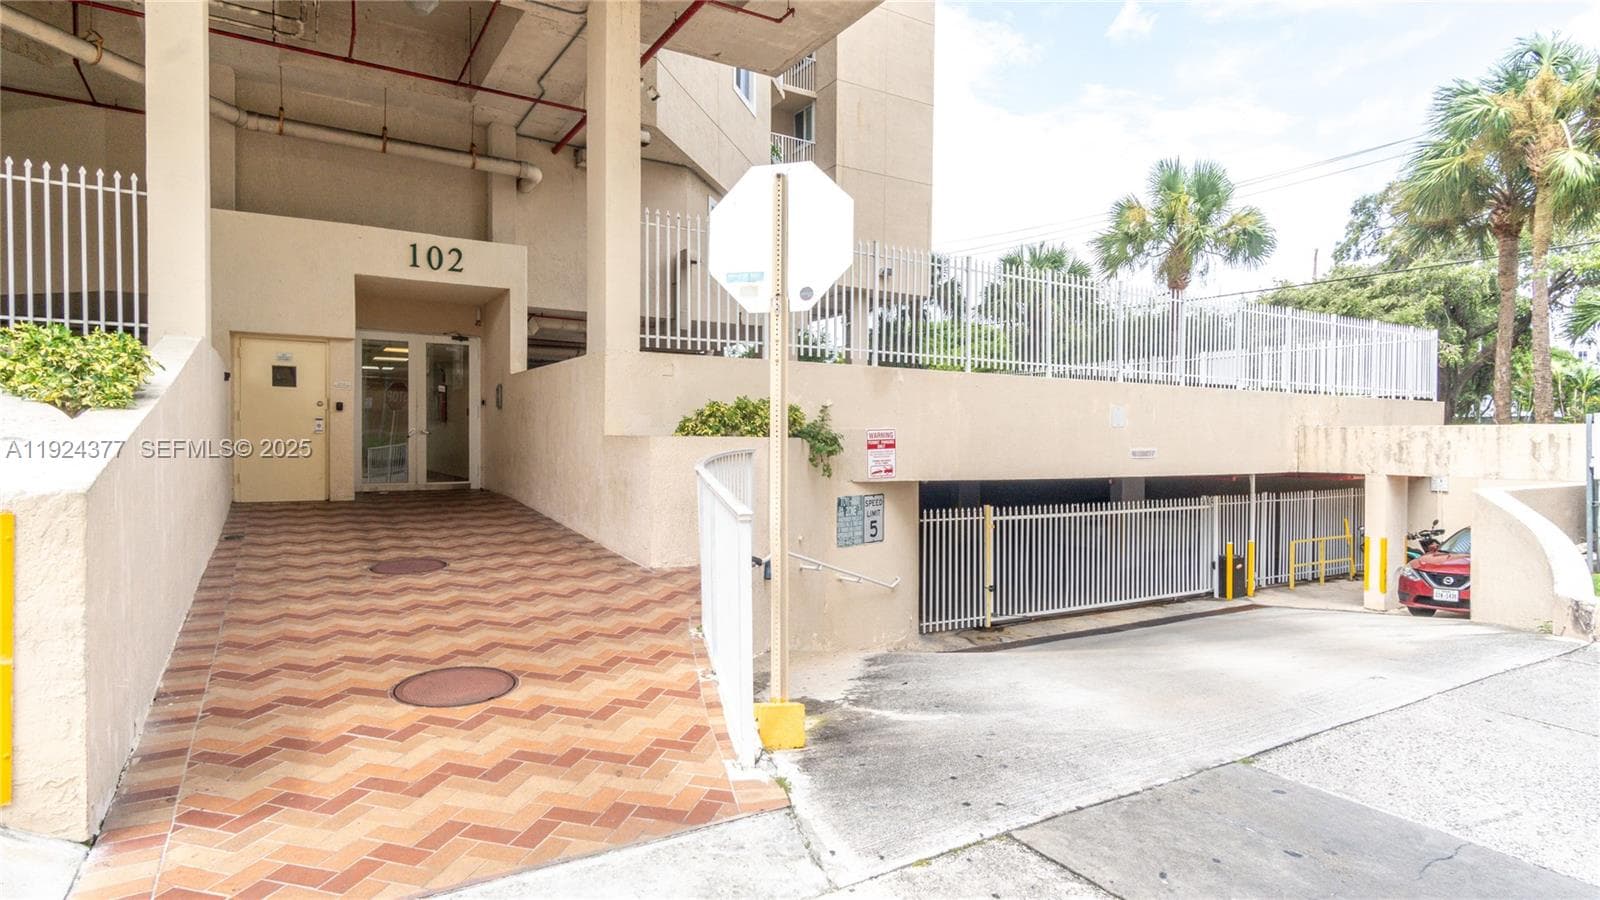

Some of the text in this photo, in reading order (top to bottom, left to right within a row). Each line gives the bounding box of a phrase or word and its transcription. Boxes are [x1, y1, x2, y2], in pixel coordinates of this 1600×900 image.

[409, 243, 464, 272] 102
[868, 431, 894, 439] WARNING
[864, 499, 882, 507] SPEED
[866, 509, 881, 518] LIMIT
[870, 520, 878, 538] 5
